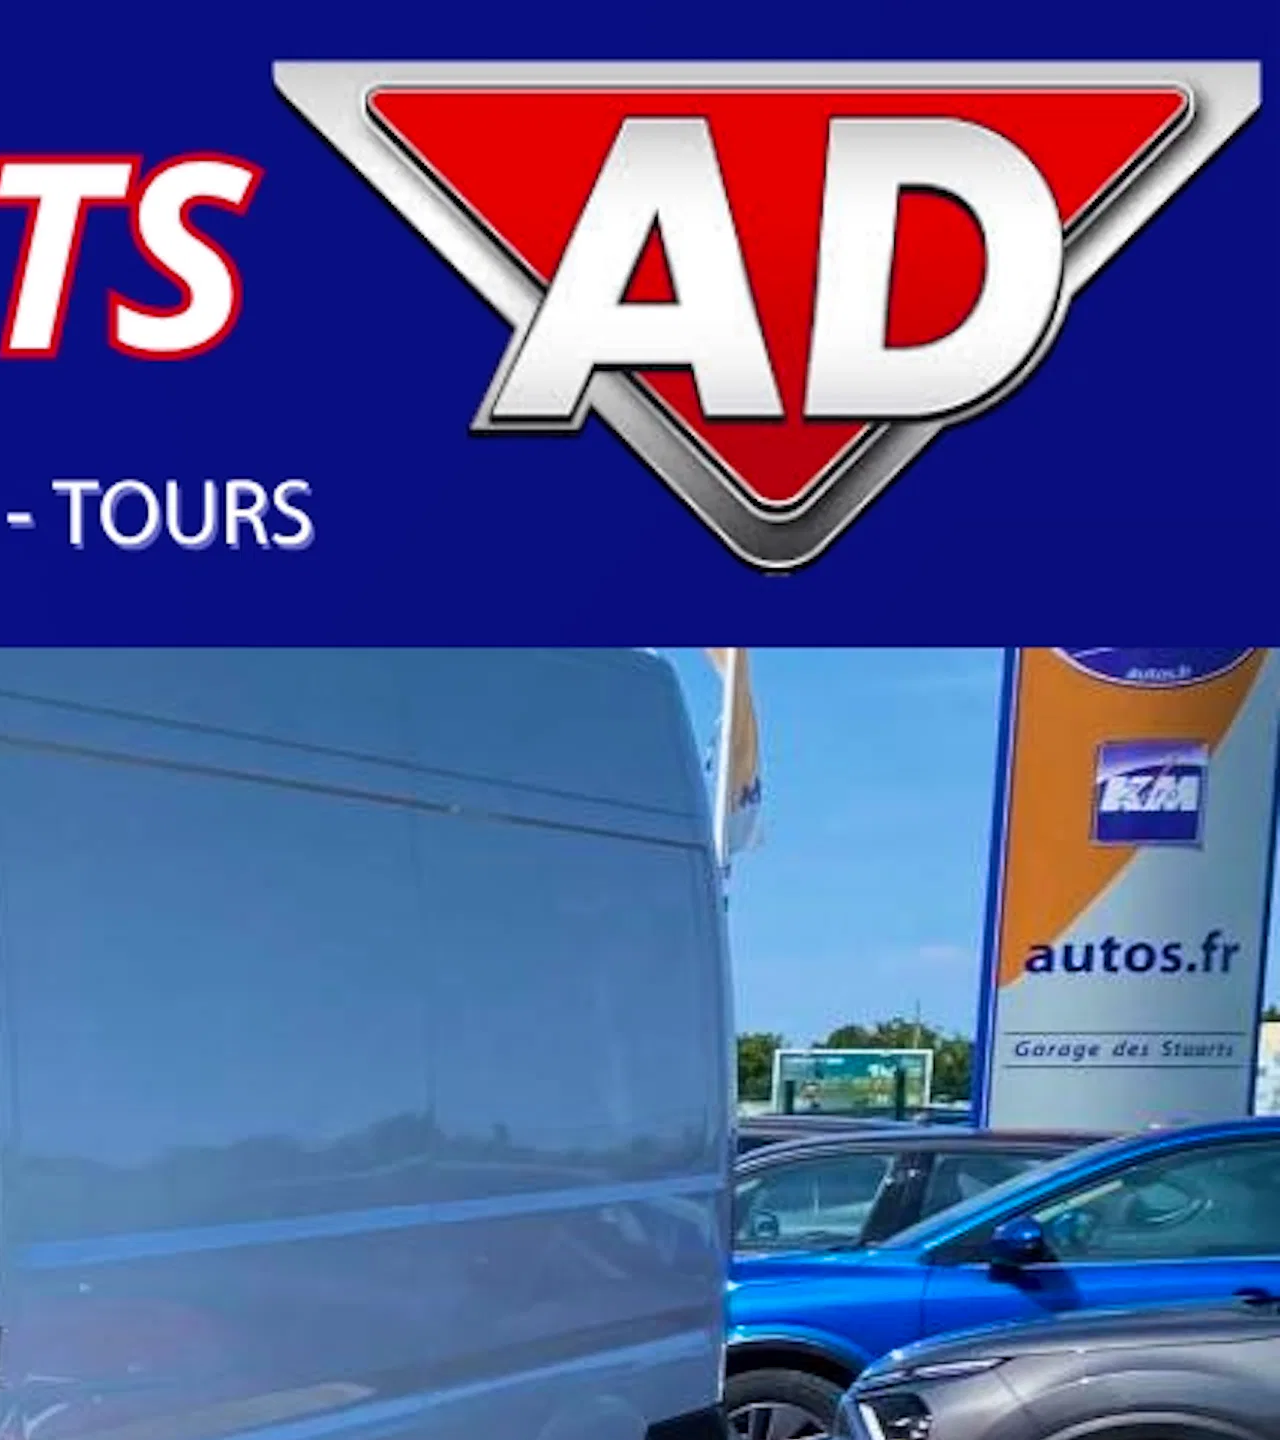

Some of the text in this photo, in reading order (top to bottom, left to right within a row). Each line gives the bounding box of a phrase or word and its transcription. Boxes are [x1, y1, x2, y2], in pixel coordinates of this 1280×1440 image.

[1025, 929, 1240, 973] autos.fr
[1015, 1039, 1099, 1062] Garage
[1112, 1040, 1149, 1057] des
